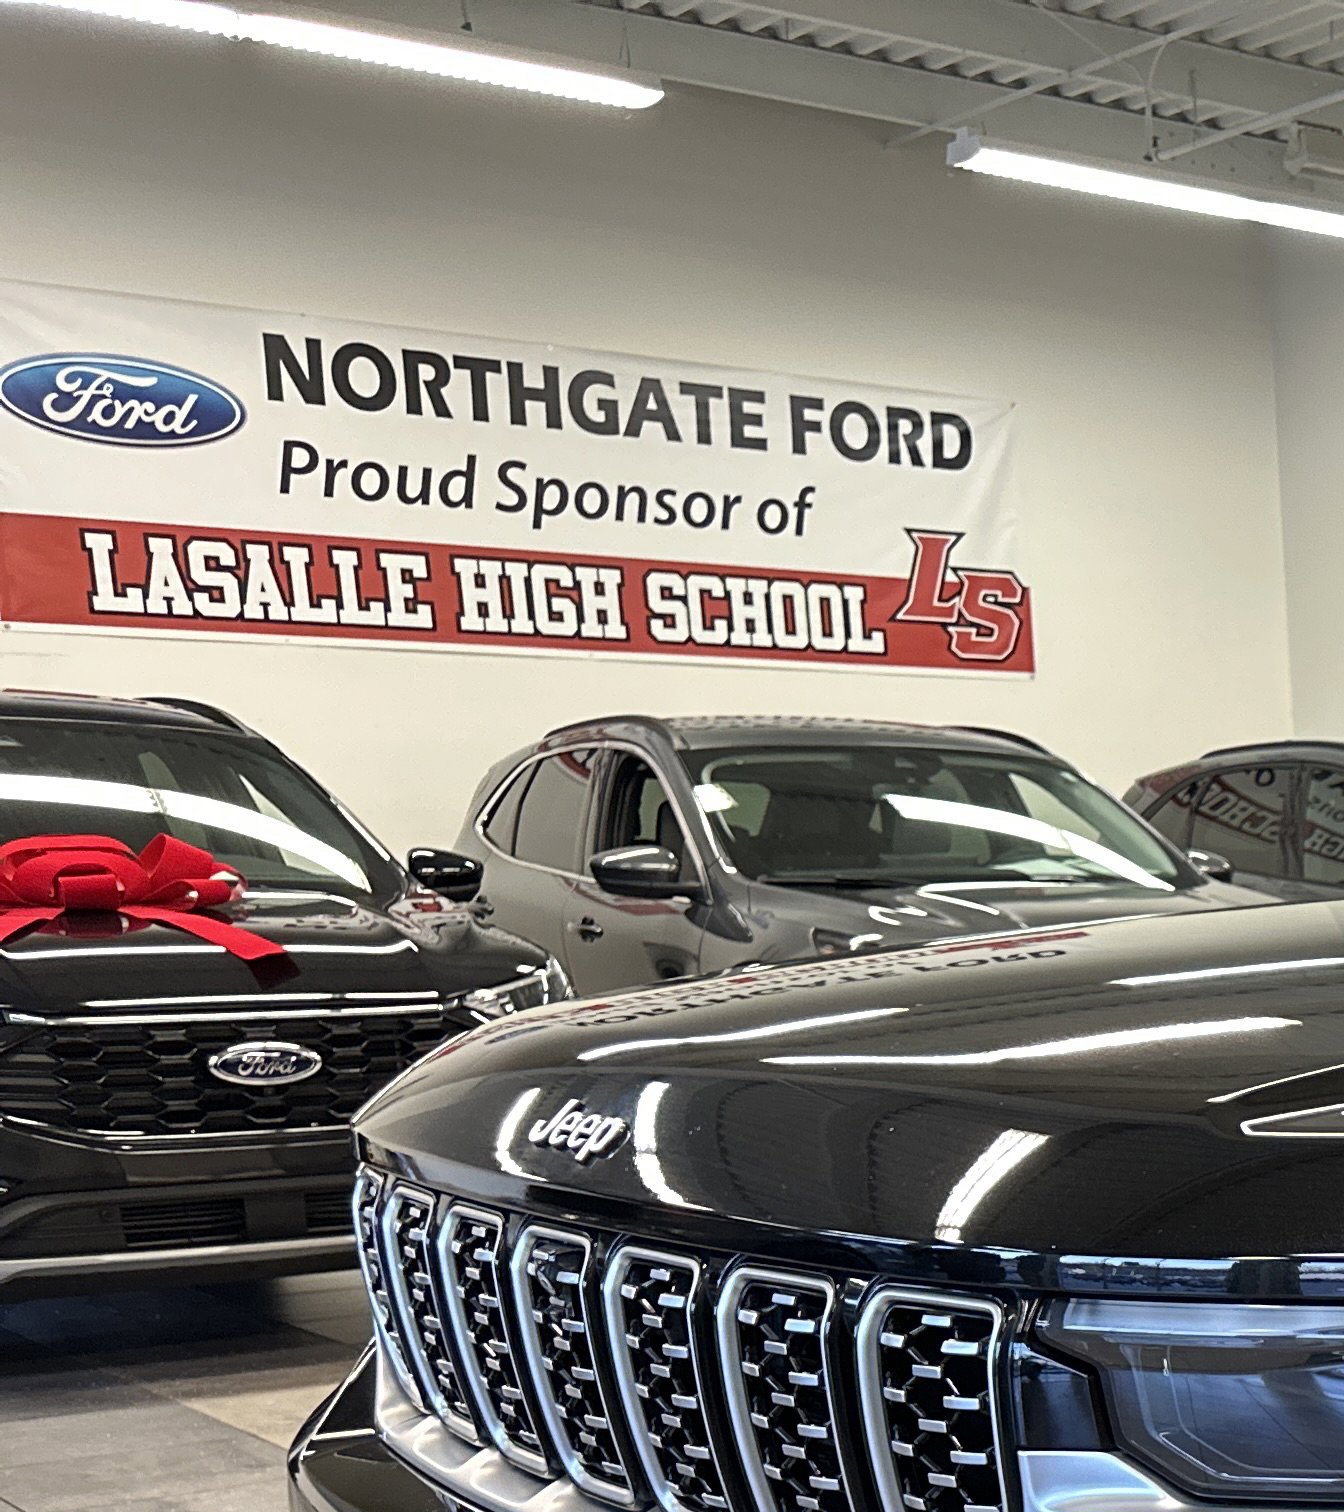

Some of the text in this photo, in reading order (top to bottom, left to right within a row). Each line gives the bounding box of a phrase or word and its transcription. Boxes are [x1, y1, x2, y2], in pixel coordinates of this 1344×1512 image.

[42, 364, 200, 435] Ford
[261, 331, 974, 471] NORTHGATE FORD
[278, 439, 816, 537] Proud Sponsor of
[80, 527, 888, 656] LASALLE HIGH SCHOOL
[237, 1051, 297, 1077] Ford
[528, 1098, 631, 1167] Jeep
